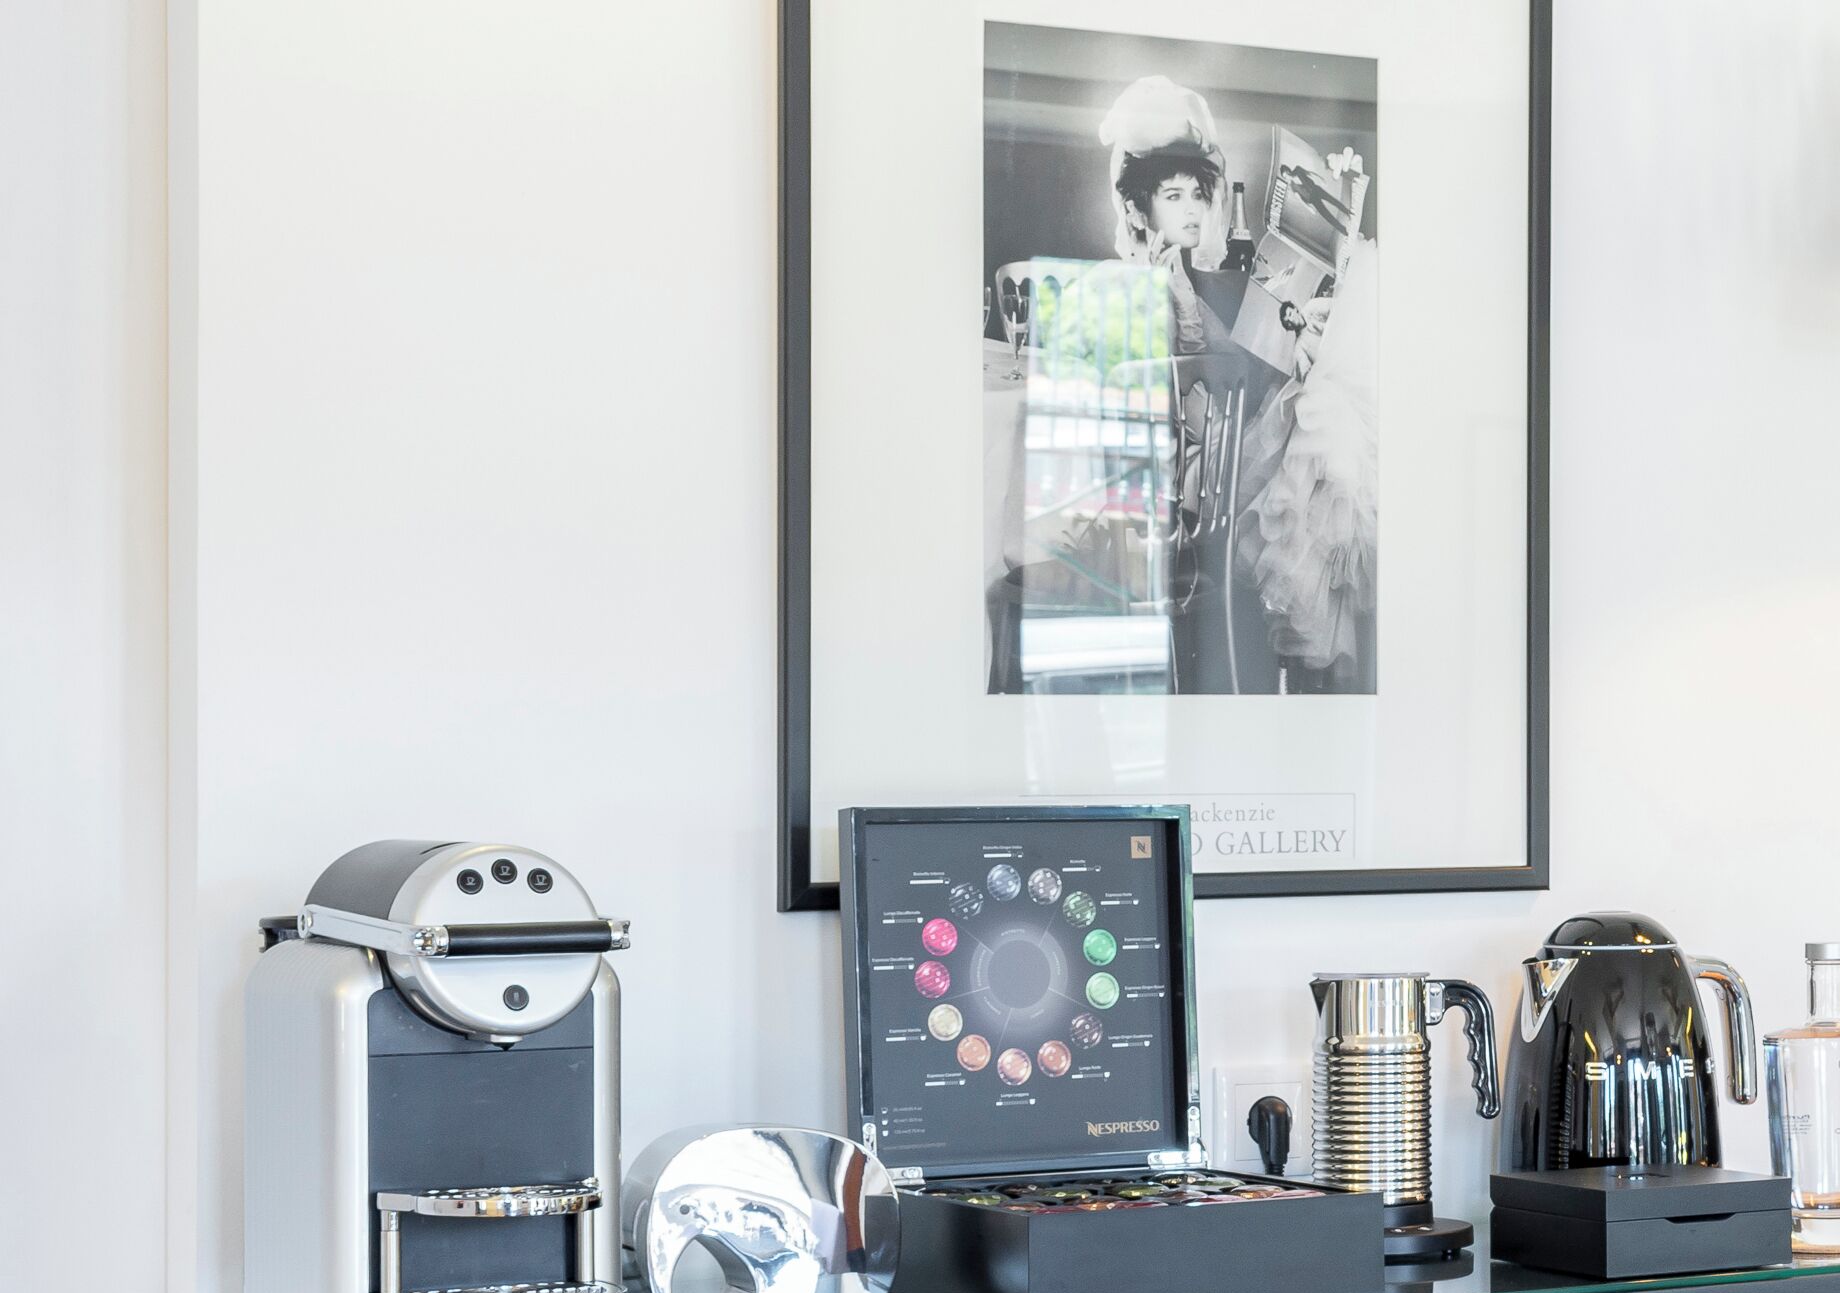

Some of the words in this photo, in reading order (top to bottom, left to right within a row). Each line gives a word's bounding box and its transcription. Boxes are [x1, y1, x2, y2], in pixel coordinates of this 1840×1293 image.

[1190, 803, 1275, 821] ackenzie
[1215, 829, 1346, 856] GALLERY
[1086, 1119, 1160, 1138] NESPRESSO
